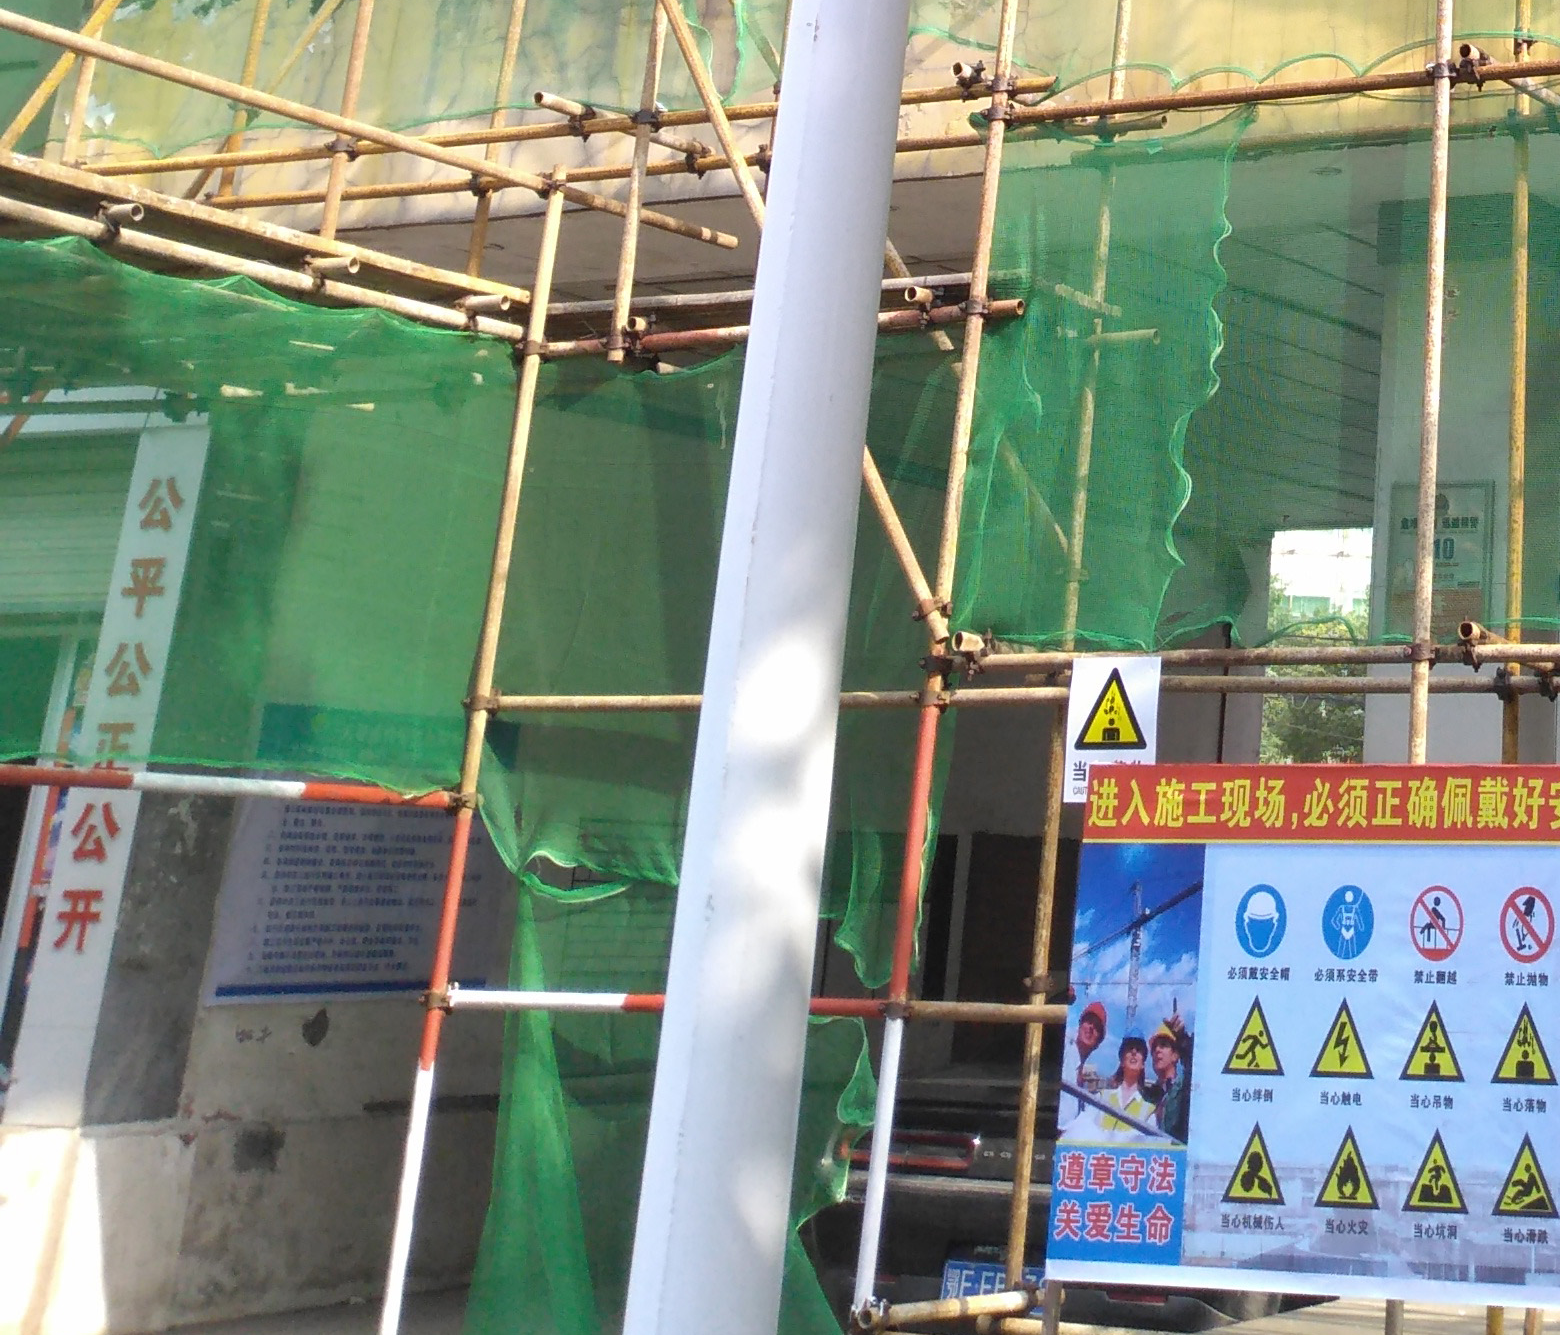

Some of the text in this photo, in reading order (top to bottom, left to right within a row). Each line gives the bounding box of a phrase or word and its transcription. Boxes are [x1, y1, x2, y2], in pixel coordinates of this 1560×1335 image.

[53, 476, 186, 955] 公平公正公开
[1227, 966, 1291, 981] 必须戴安全帽
[1313, 967, 1379, 983] 必须系安全带
[1414, 969, 1457, 985] 禁止翻越
[1504, 971, 1549, 987] 禁止抛物
[1231, 1088, 1274, 1103] 当心绊倒
[1319, 1090, 1363, 1106] 当心触电
[1410, 1094, 1454, 1110] 当心吊物
[1502, 1098, 1547, 1114] 当心落物
[1056, 1152, 1177, 1195] 遵章守法
[1054, 1200, 1174, 1246] 关爱生命
[1220, 1213, 1285, 1230] 当心机械伤人
[1325, 1218, 1369, 1235] 当心火灾
[1413, 1223, 1458, 1240] 当心坑洞
[1503, 1227, 1549, 1244] 当心滑跌
